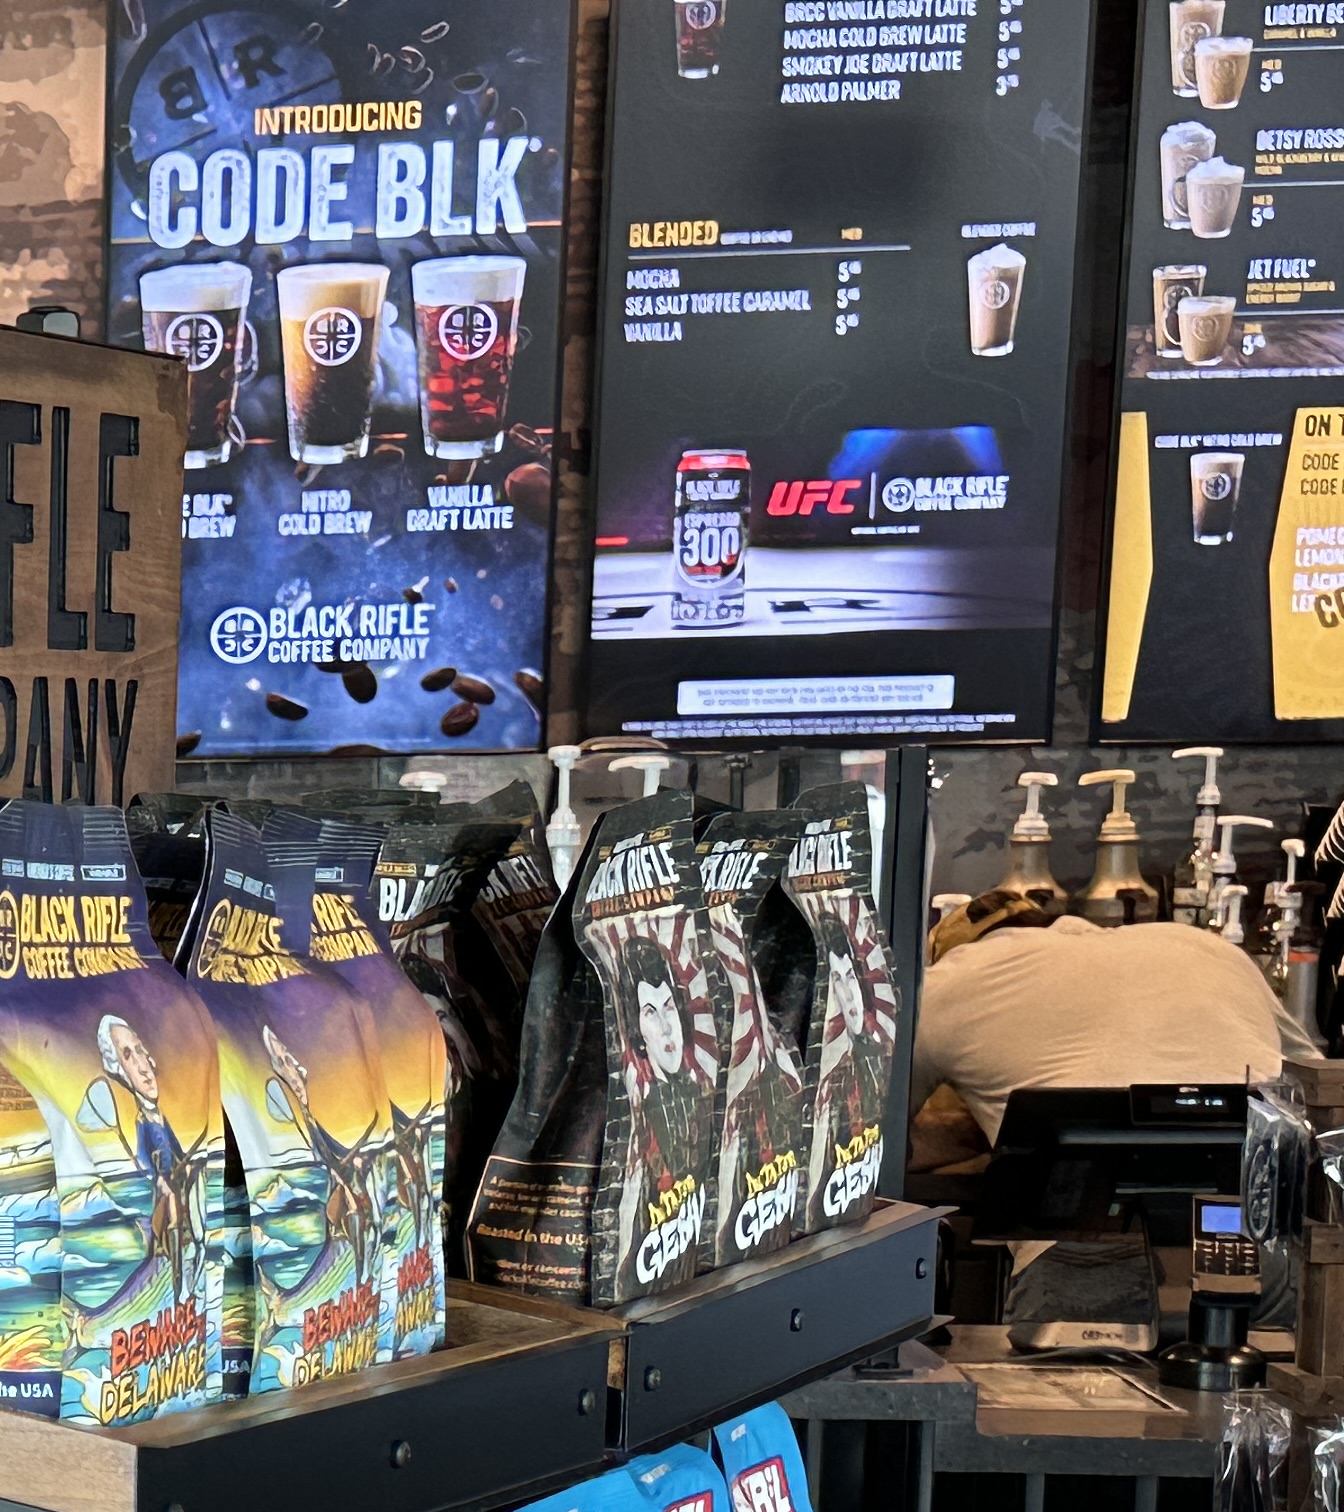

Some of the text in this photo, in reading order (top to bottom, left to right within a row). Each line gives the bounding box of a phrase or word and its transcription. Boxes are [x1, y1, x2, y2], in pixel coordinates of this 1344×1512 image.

[879, 25, 923, 46] BREW
[925, 23, 966, 44] LATTE
[920, 51, 962, 71] LATTE
[254, 101, 422, 135] INTRODUCING
[149, 137, 530, 249] CODE BLK
[629, 220, 719, 247] BLENDED
[1305, 415, 1331, 436] ON
[1303, 453, 1340, 471] CODE
[428, 485, 493, 507] VANILLA
[767, 480, 862, 516] UFC
[1301, 478, 1337, 495] CODE
[302, 490, 351, 512] NITRO
[278, 510, 372, 536] COLD BREW
[407, 505, 514, 531] DRAFT LATTE
[683, 527, 741, 566] 300
[270, 603, 431, 638] BLACK RIFLE
[268, 637, 430, 663] COFFEE COMPANY
[21, 894, 132, 943] BLACK RIFLE
[22, 946, 74, 979] COFFEE
[538, 1230, 563, 1245] the
[20, 1383, 54, 1398] USA
[100, 1344, 206, 1425] DELAWARE
